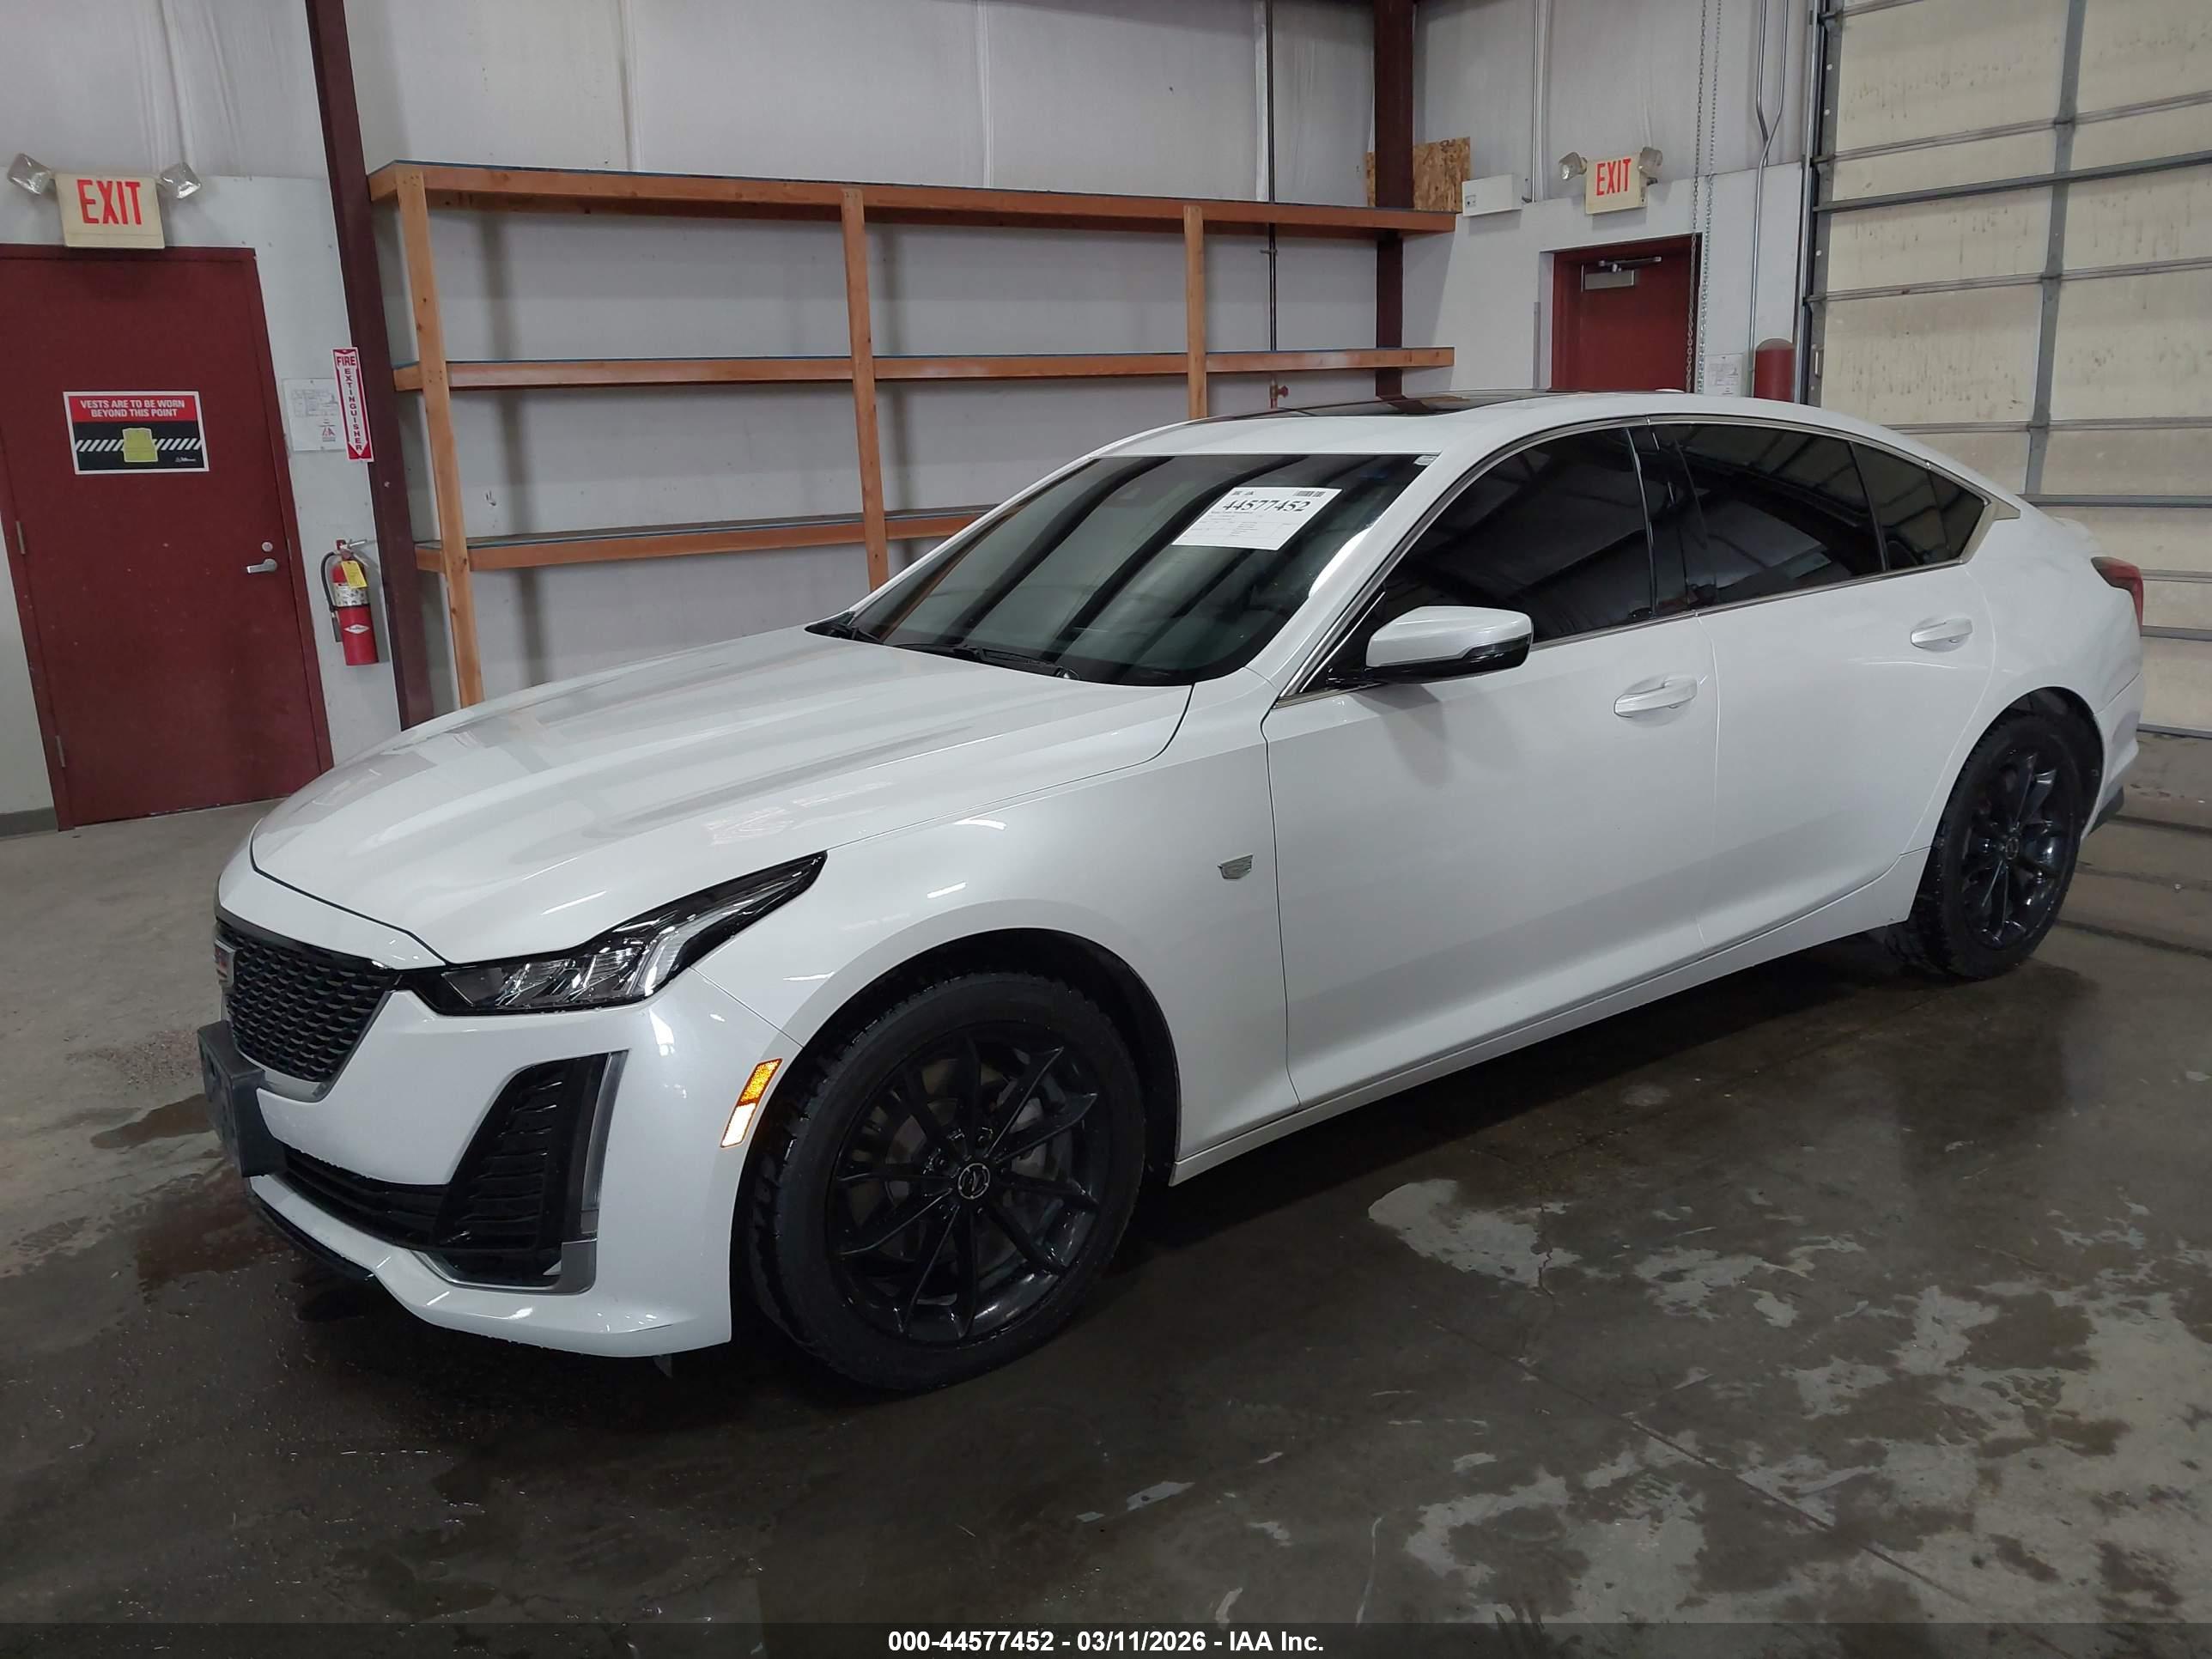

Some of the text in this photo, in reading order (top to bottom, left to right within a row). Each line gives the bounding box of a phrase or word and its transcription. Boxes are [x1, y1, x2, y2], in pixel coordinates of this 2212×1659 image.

[1596, 158, 1632, 196] EXIT
[76, 179, 143, 225] EXIT
[336, 356, 356, 367] FIRE
[80, 399, 185, 409] VESTS ARE TO BE WORN
[343, 368, 362, 451] EXTINGUISHER
[90, 408, 178, 418] BEYOND THIS POINT
[1223, 500, 1311, 512] 44577452
